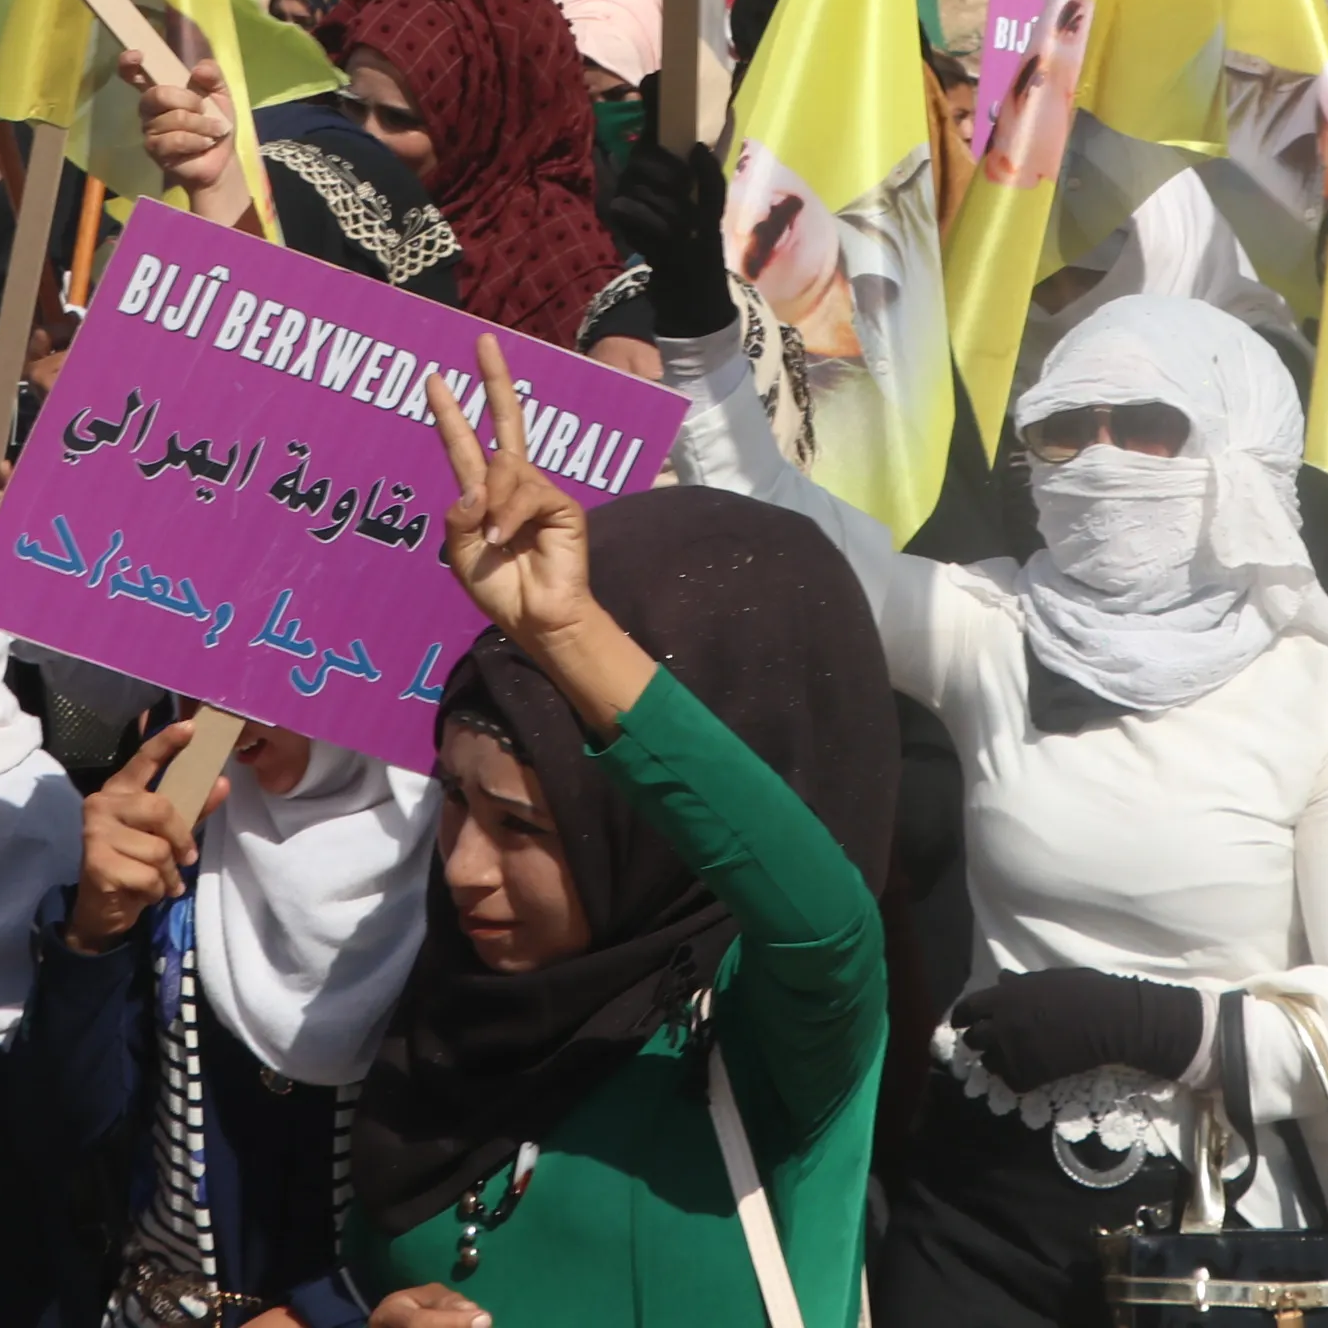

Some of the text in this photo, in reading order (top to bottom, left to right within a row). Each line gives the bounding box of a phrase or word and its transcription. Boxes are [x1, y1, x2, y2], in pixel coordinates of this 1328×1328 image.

[993, 16, 1040, 54] BIJ
[118, 254, 231, 339] BIJÎ
[513, 379, 644, 496] MRALI
[62, 386, 430, 552] مقاومة ايمرالي
